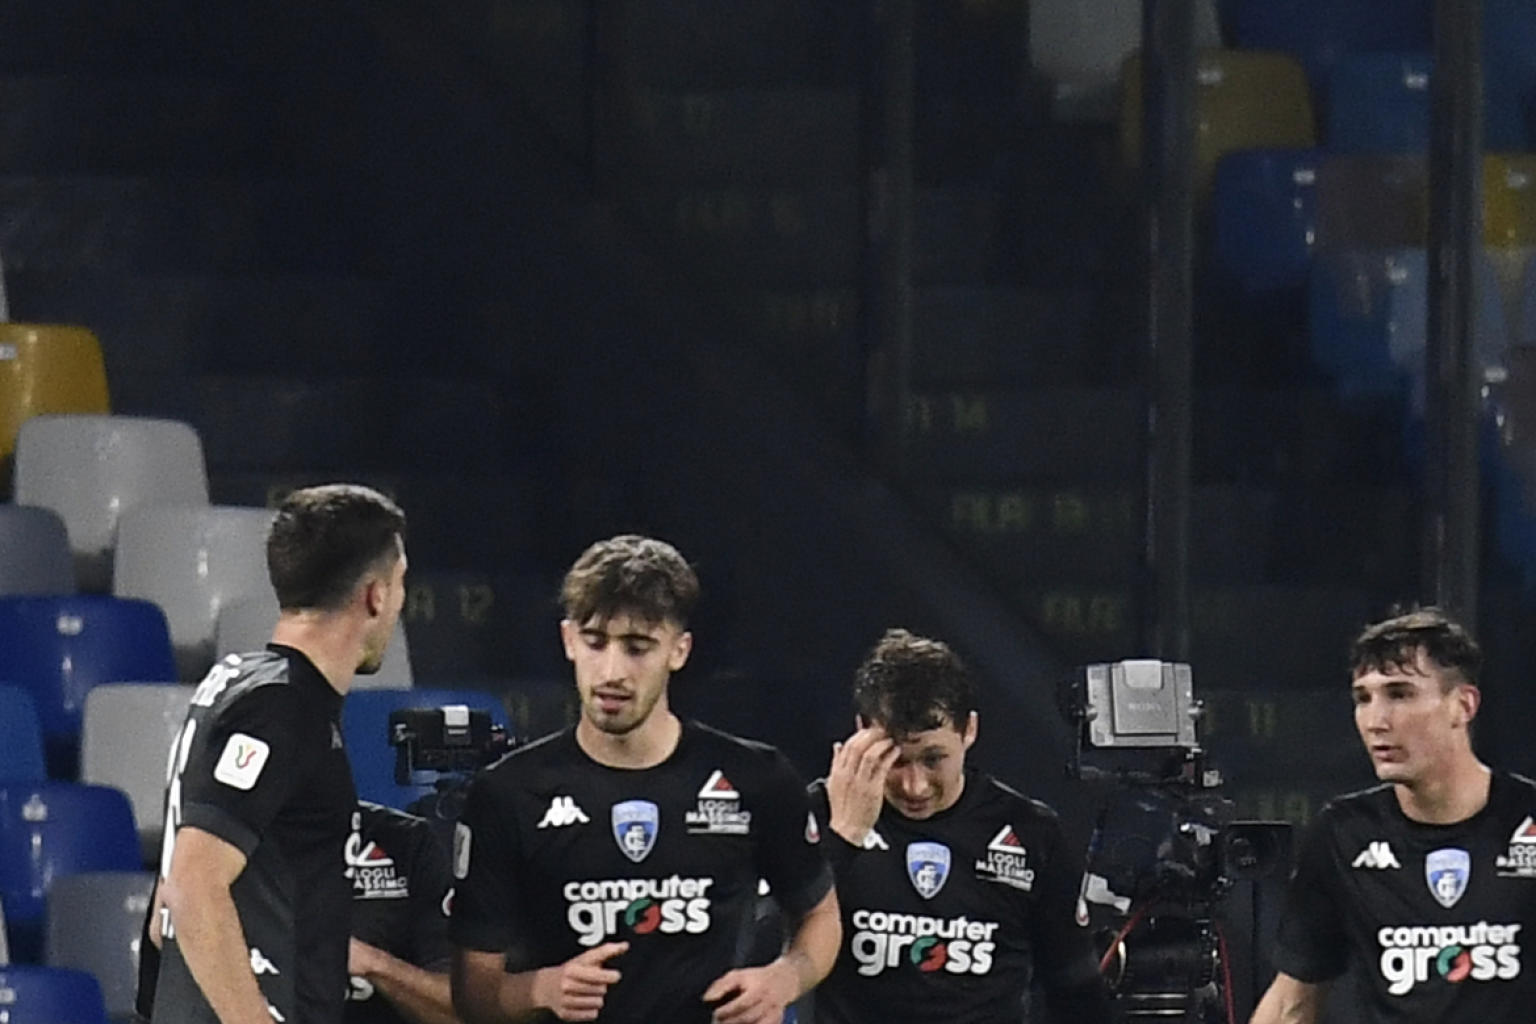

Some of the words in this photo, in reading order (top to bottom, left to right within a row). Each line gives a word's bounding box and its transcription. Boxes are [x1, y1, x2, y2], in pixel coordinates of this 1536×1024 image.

[976, 860, 1034, 880] MASSIMO
[988, 852, 1025, 867] LOGLI
[353, 878, 407, 889] ASSIMO
[564, 874, 713, 901] computer
[567, 897, 711, 947] gross
[853, 910, 999, 940] computer
[1378, 921, 1521, 946] computer
[851, 931, 995, 976] gross
[1380, 944, 1520, 995] gross
